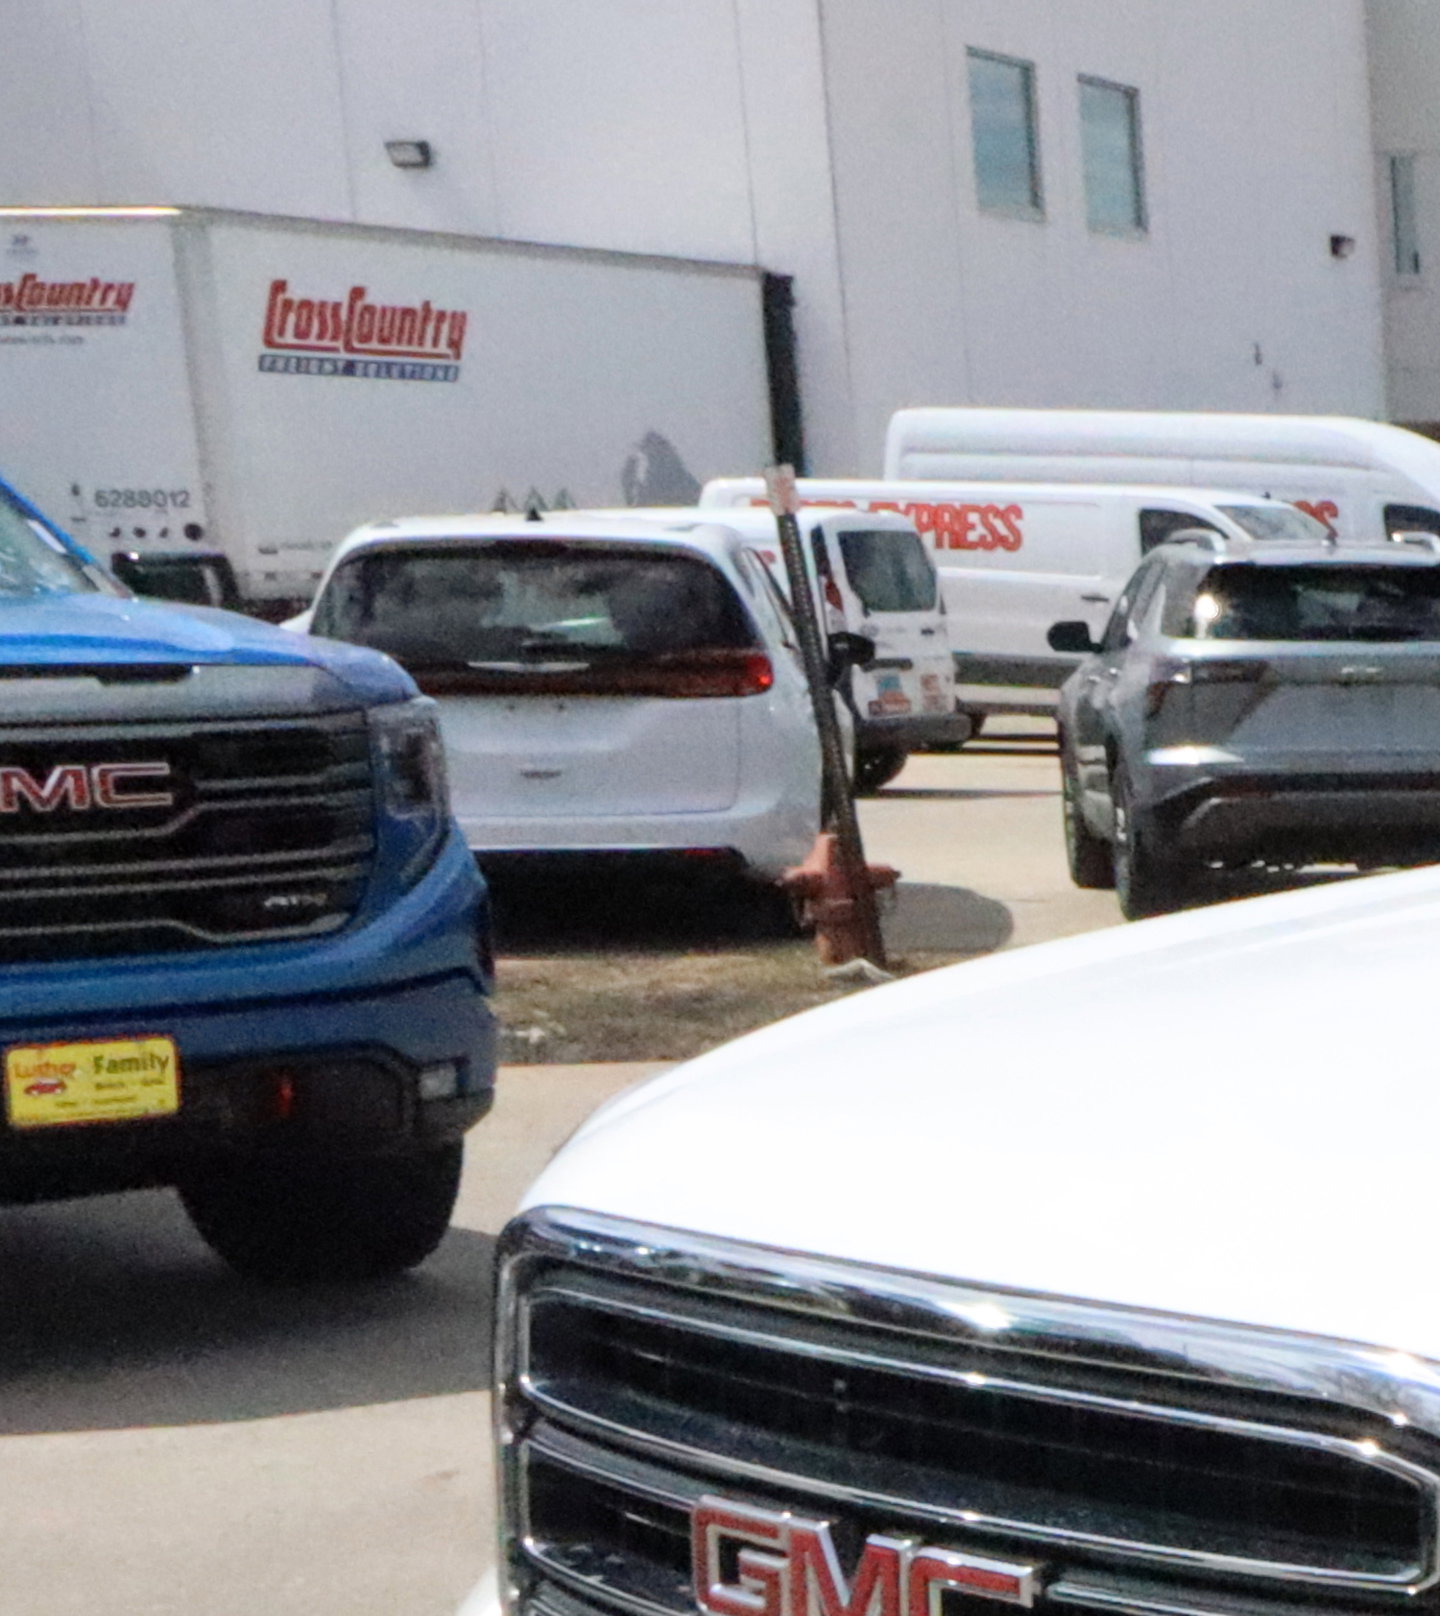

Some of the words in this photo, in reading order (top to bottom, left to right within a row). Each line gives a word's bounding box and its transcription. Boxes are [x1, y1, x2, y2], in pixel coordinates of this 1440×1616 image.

[0, 272, 134, 313] sCountry
[262, 279, 467, 361] CrossCountry
[868, 501, 1023, 552] PRESS
[0, 762, 173, 813] MC
[93, 1054, 169, 1077] Family
